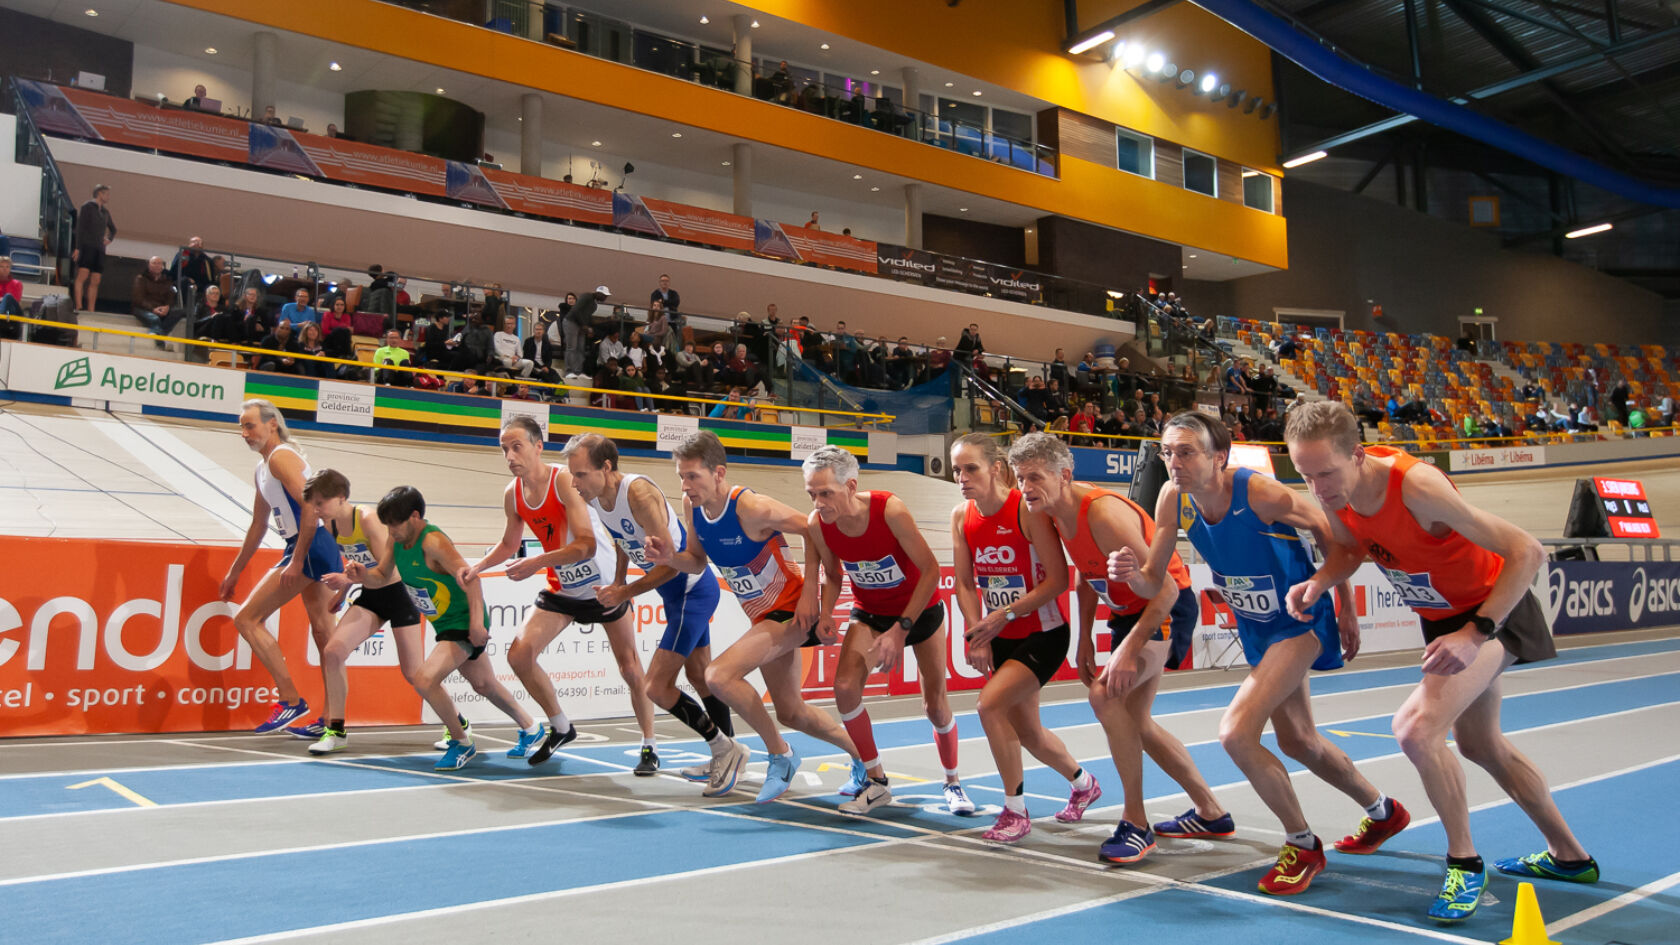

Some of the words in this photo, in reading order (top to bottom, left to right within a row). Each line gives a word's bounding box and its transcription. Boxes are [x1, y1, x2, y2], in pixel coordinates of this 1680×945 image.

[101, 366, 225, 400] Apeldoorn
[321, 401, 371, 413] Gelderland
[975, 545, 1016, 565] ACO
[559, 564, 592, 583] 5049
[855, 569, 894, 583] 5507
[1222, 588, 1270, 612] 5510
[1377, 586, 1408, 608] herz
[1566, 579, 1614, 618] asics
[66, 684, 146, 712] sport
